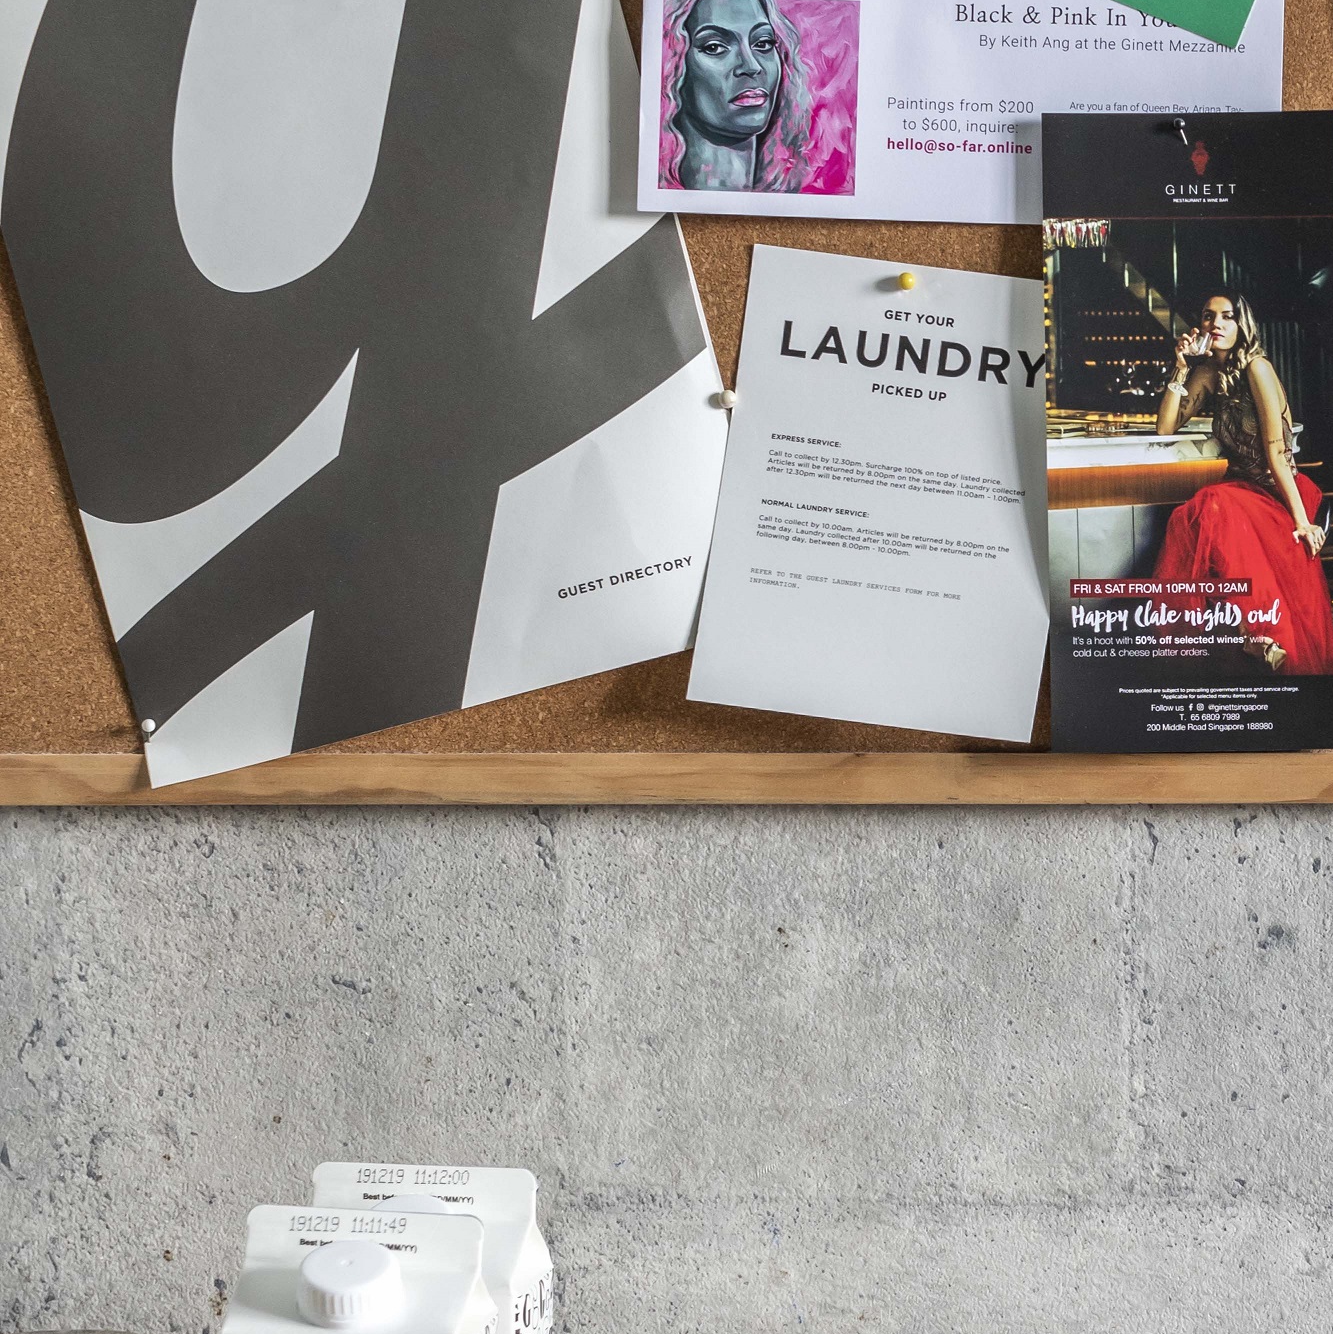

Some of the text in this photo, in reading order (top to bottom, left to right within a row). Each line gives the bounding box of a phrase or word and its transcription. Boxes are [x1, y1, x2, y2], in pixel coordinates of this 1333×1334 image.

[955, 3, 1013, 24] Black
[1022, 5, 1041, 25] &
[1050, 6, 1097, 26] Pink
[1105, 6, 1128, 27] In
[887, 137, 1037, 159] hello@so-far.online
[1164, 183, 1236, 196] GINETT
[884, 309, 955, 328] GET YOUR
[780, 320, 1045, 389] LAUNDRY
[871, 383, 947, 402] PICKED UP
[557, 555, 692, 599] GUEST DIRECTORY
[1071, 604, 1129, 632] Happy
[1247, 599, 1282, 626] owl
[356, 1167, 405, 1185] 191219
[288, 1215, 341, 1233] 191219
